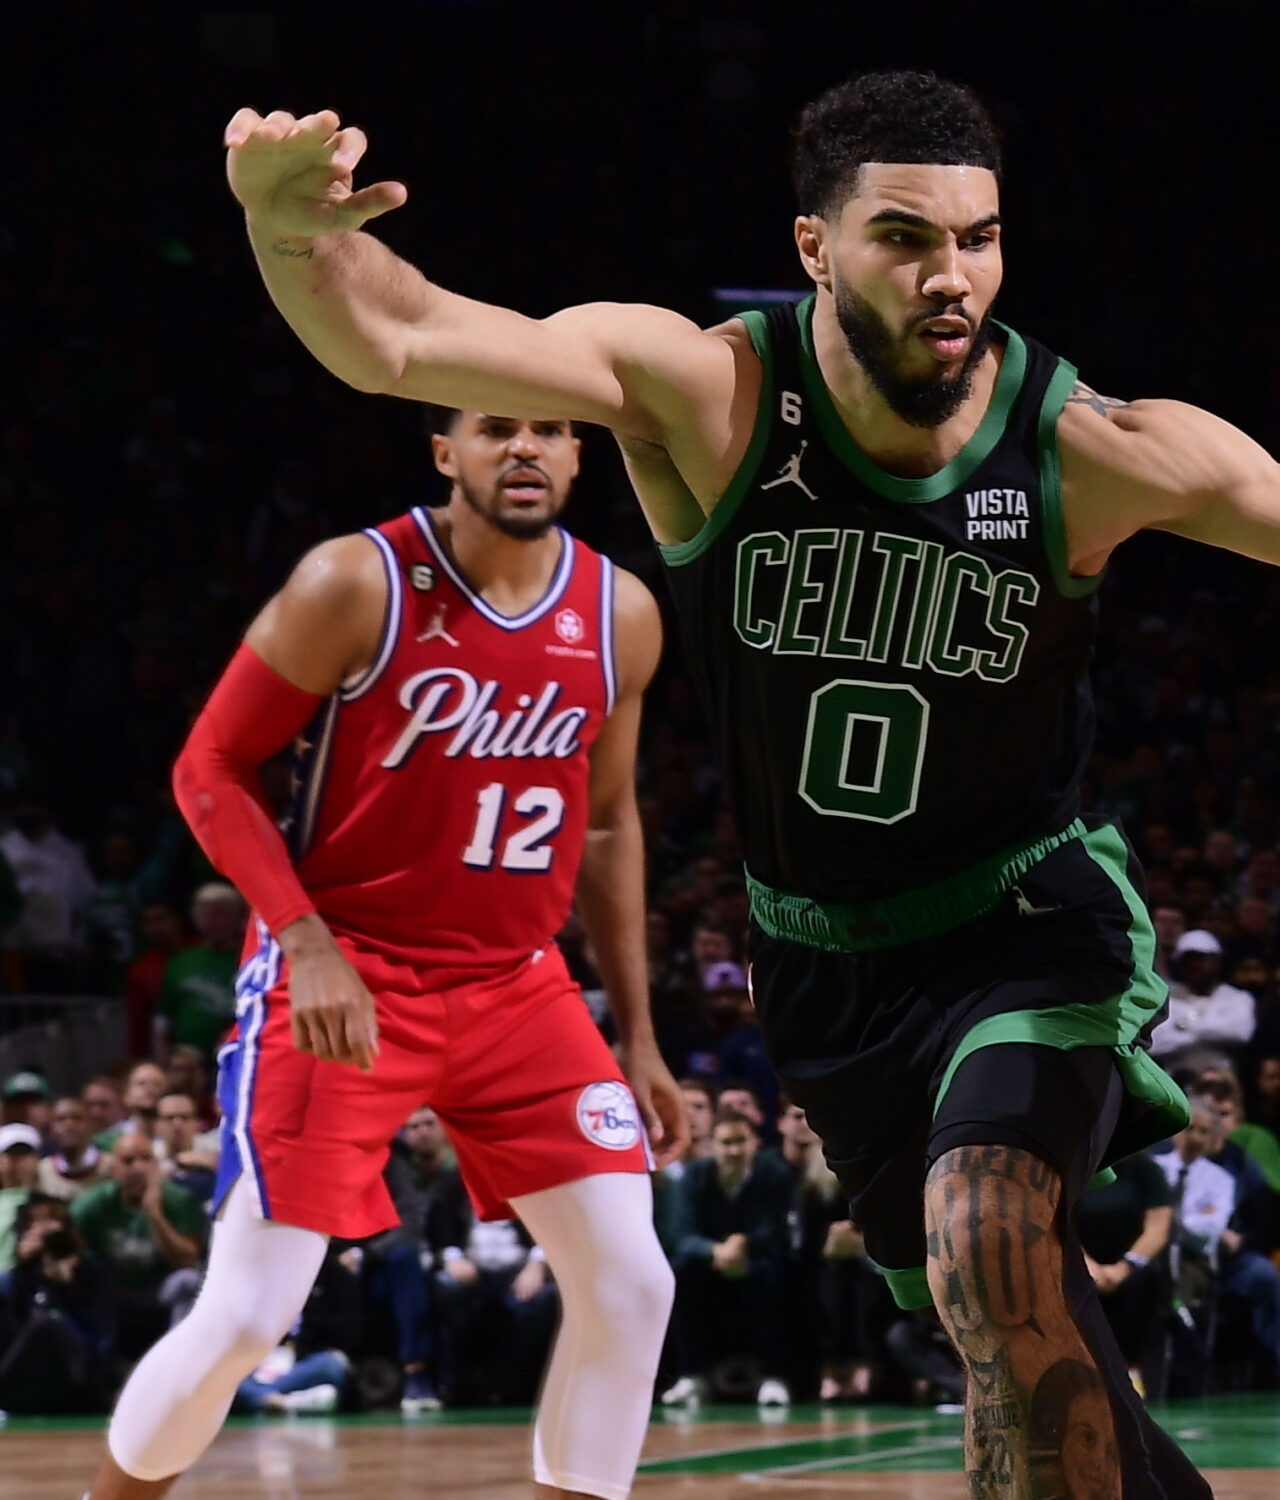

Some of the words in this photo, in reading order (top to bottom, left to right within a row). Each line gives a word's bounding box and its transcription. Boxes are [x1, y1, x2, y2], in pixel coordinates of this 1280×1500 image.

[781, 391, 802, 425] 6
[965, 488, 1030, 518] VISTA
[967, 519, 1029, 541] PRINT
[733, 528, 1040, 684] CELTICS
[380, 667, 588, 770] Phila
[798, 678, 931, 825] 0
[462, 782, 567, 872] 12
